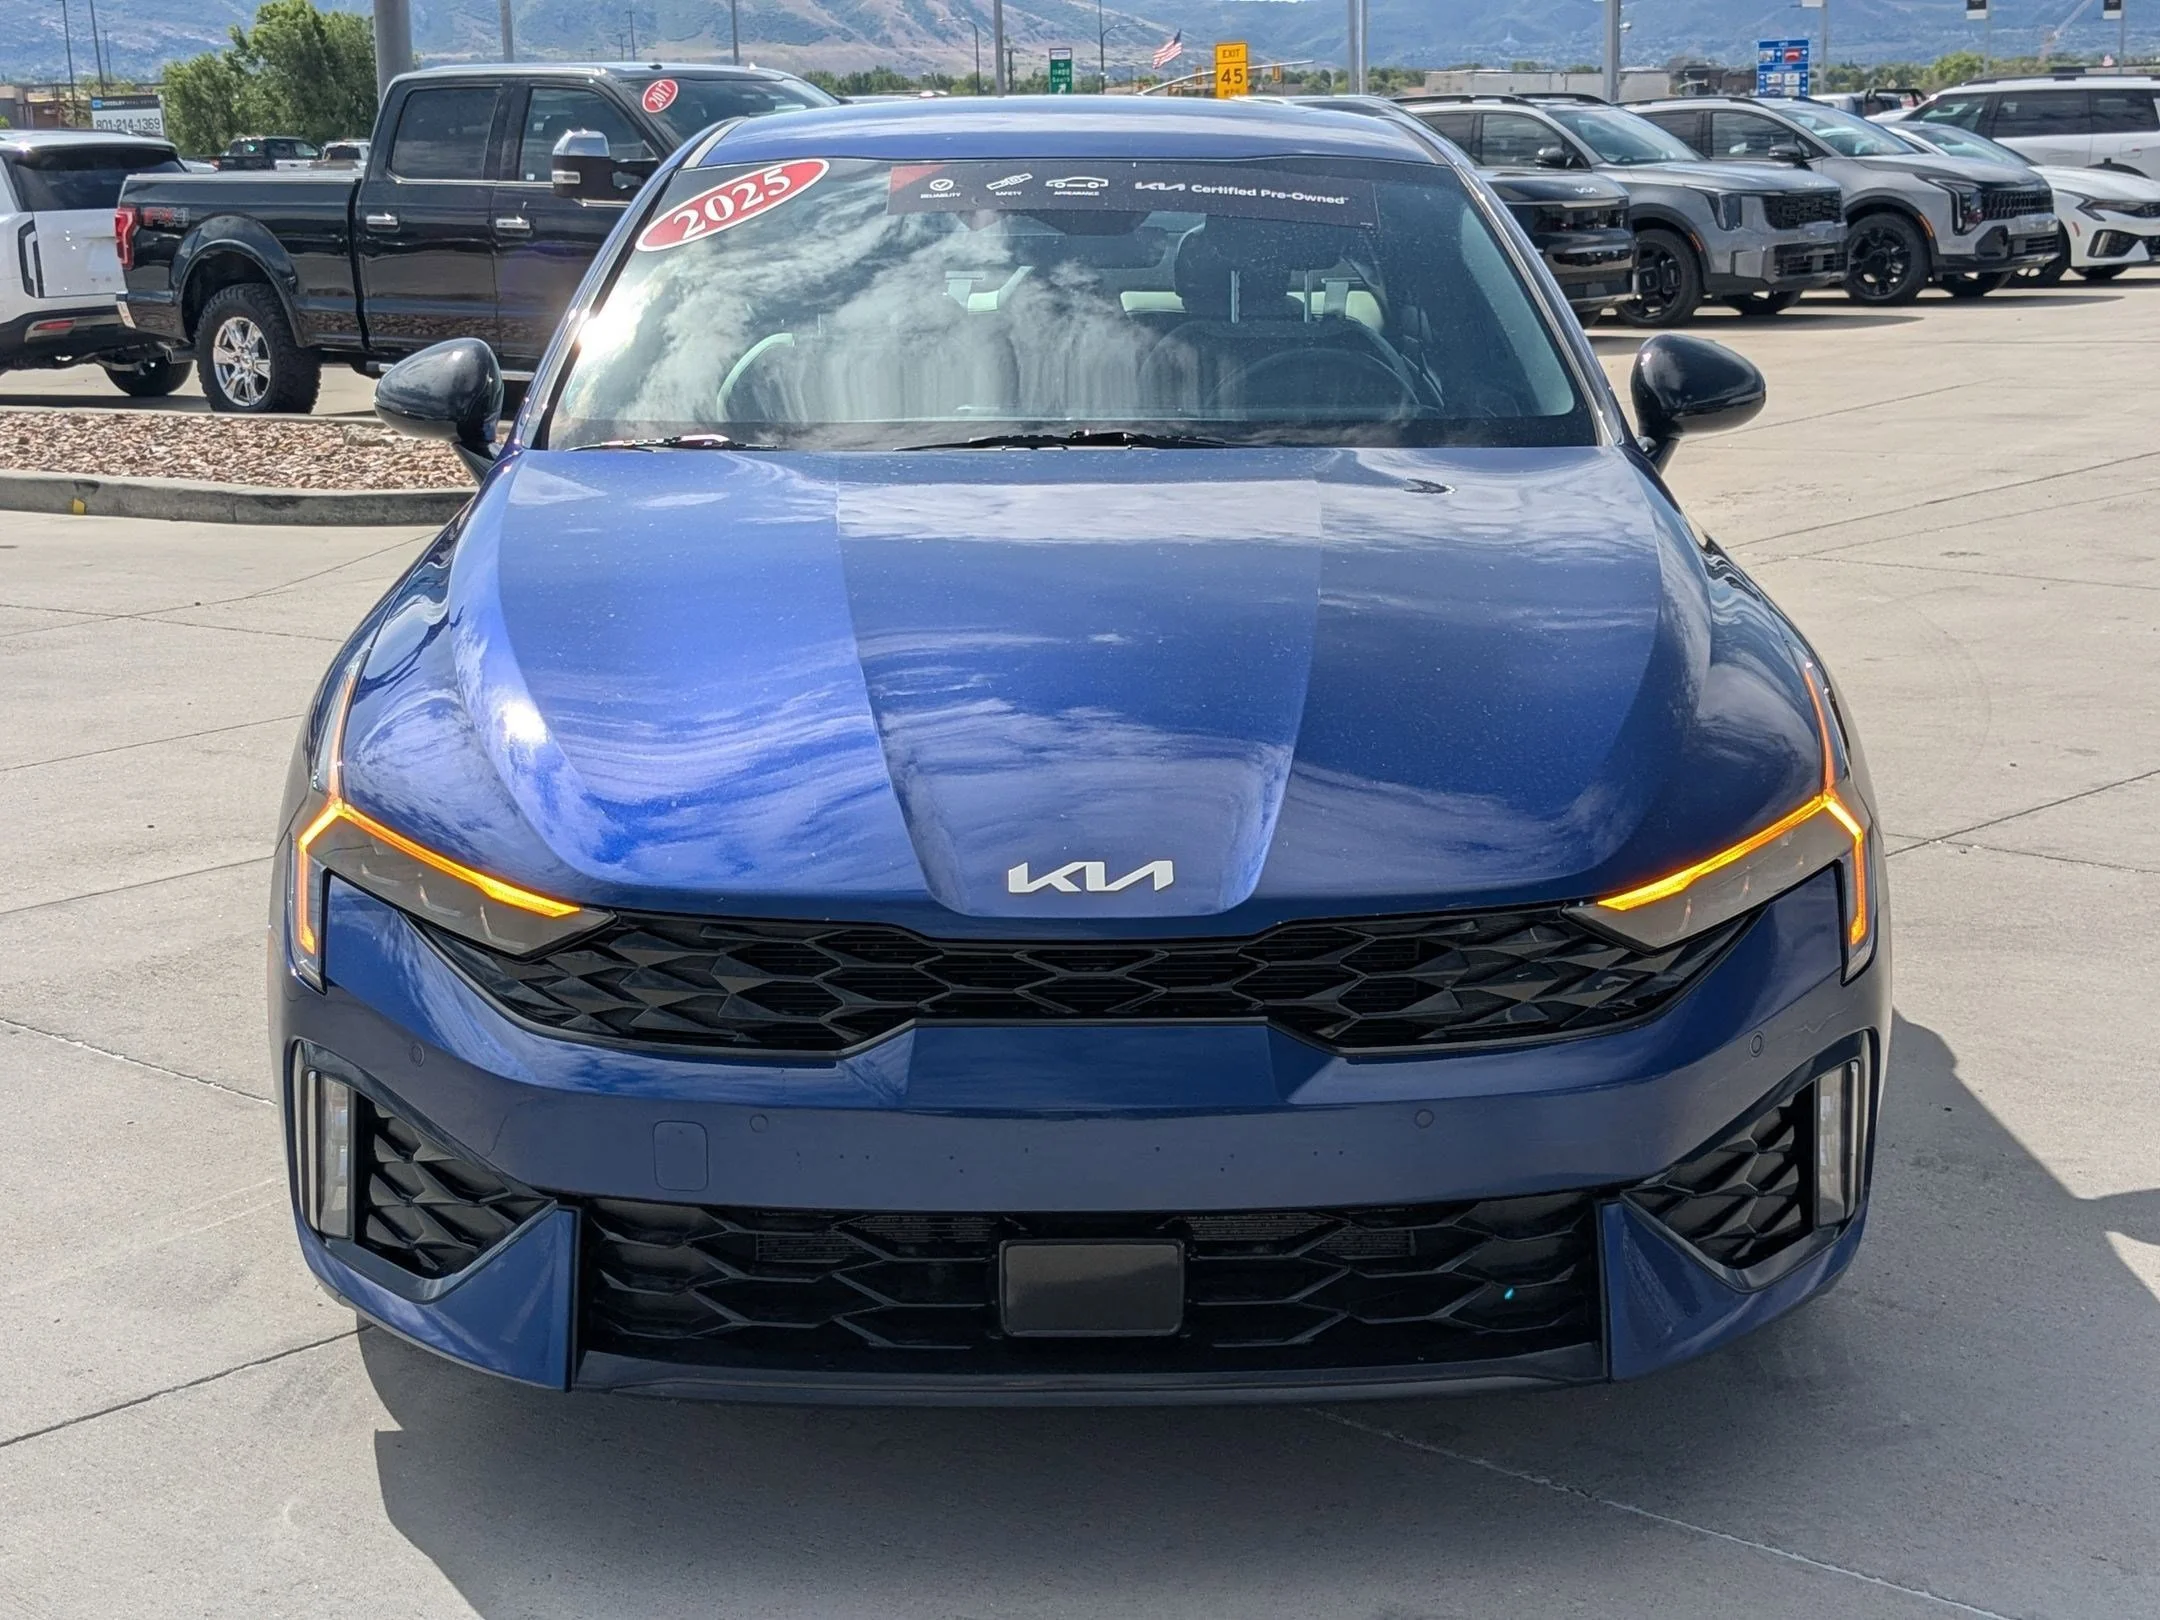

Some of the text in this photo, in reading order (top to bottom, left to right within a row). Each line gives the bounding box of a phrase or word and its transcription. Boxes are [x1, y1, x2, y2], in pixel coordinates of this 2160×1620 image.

[1222, 48, 1241, 59] EXIT
[1220, 68, 1243, 85] 45
[648, 82, 673, 108] 2017
[95, 118, 161, 131] 801-214-1369
[1134, 181, 1186, 191] KIA
[1190, 184, 1257, 197] Certified
[673, 168, 792, 240] 2025
[1008, 860, 1175, 893] KIA
